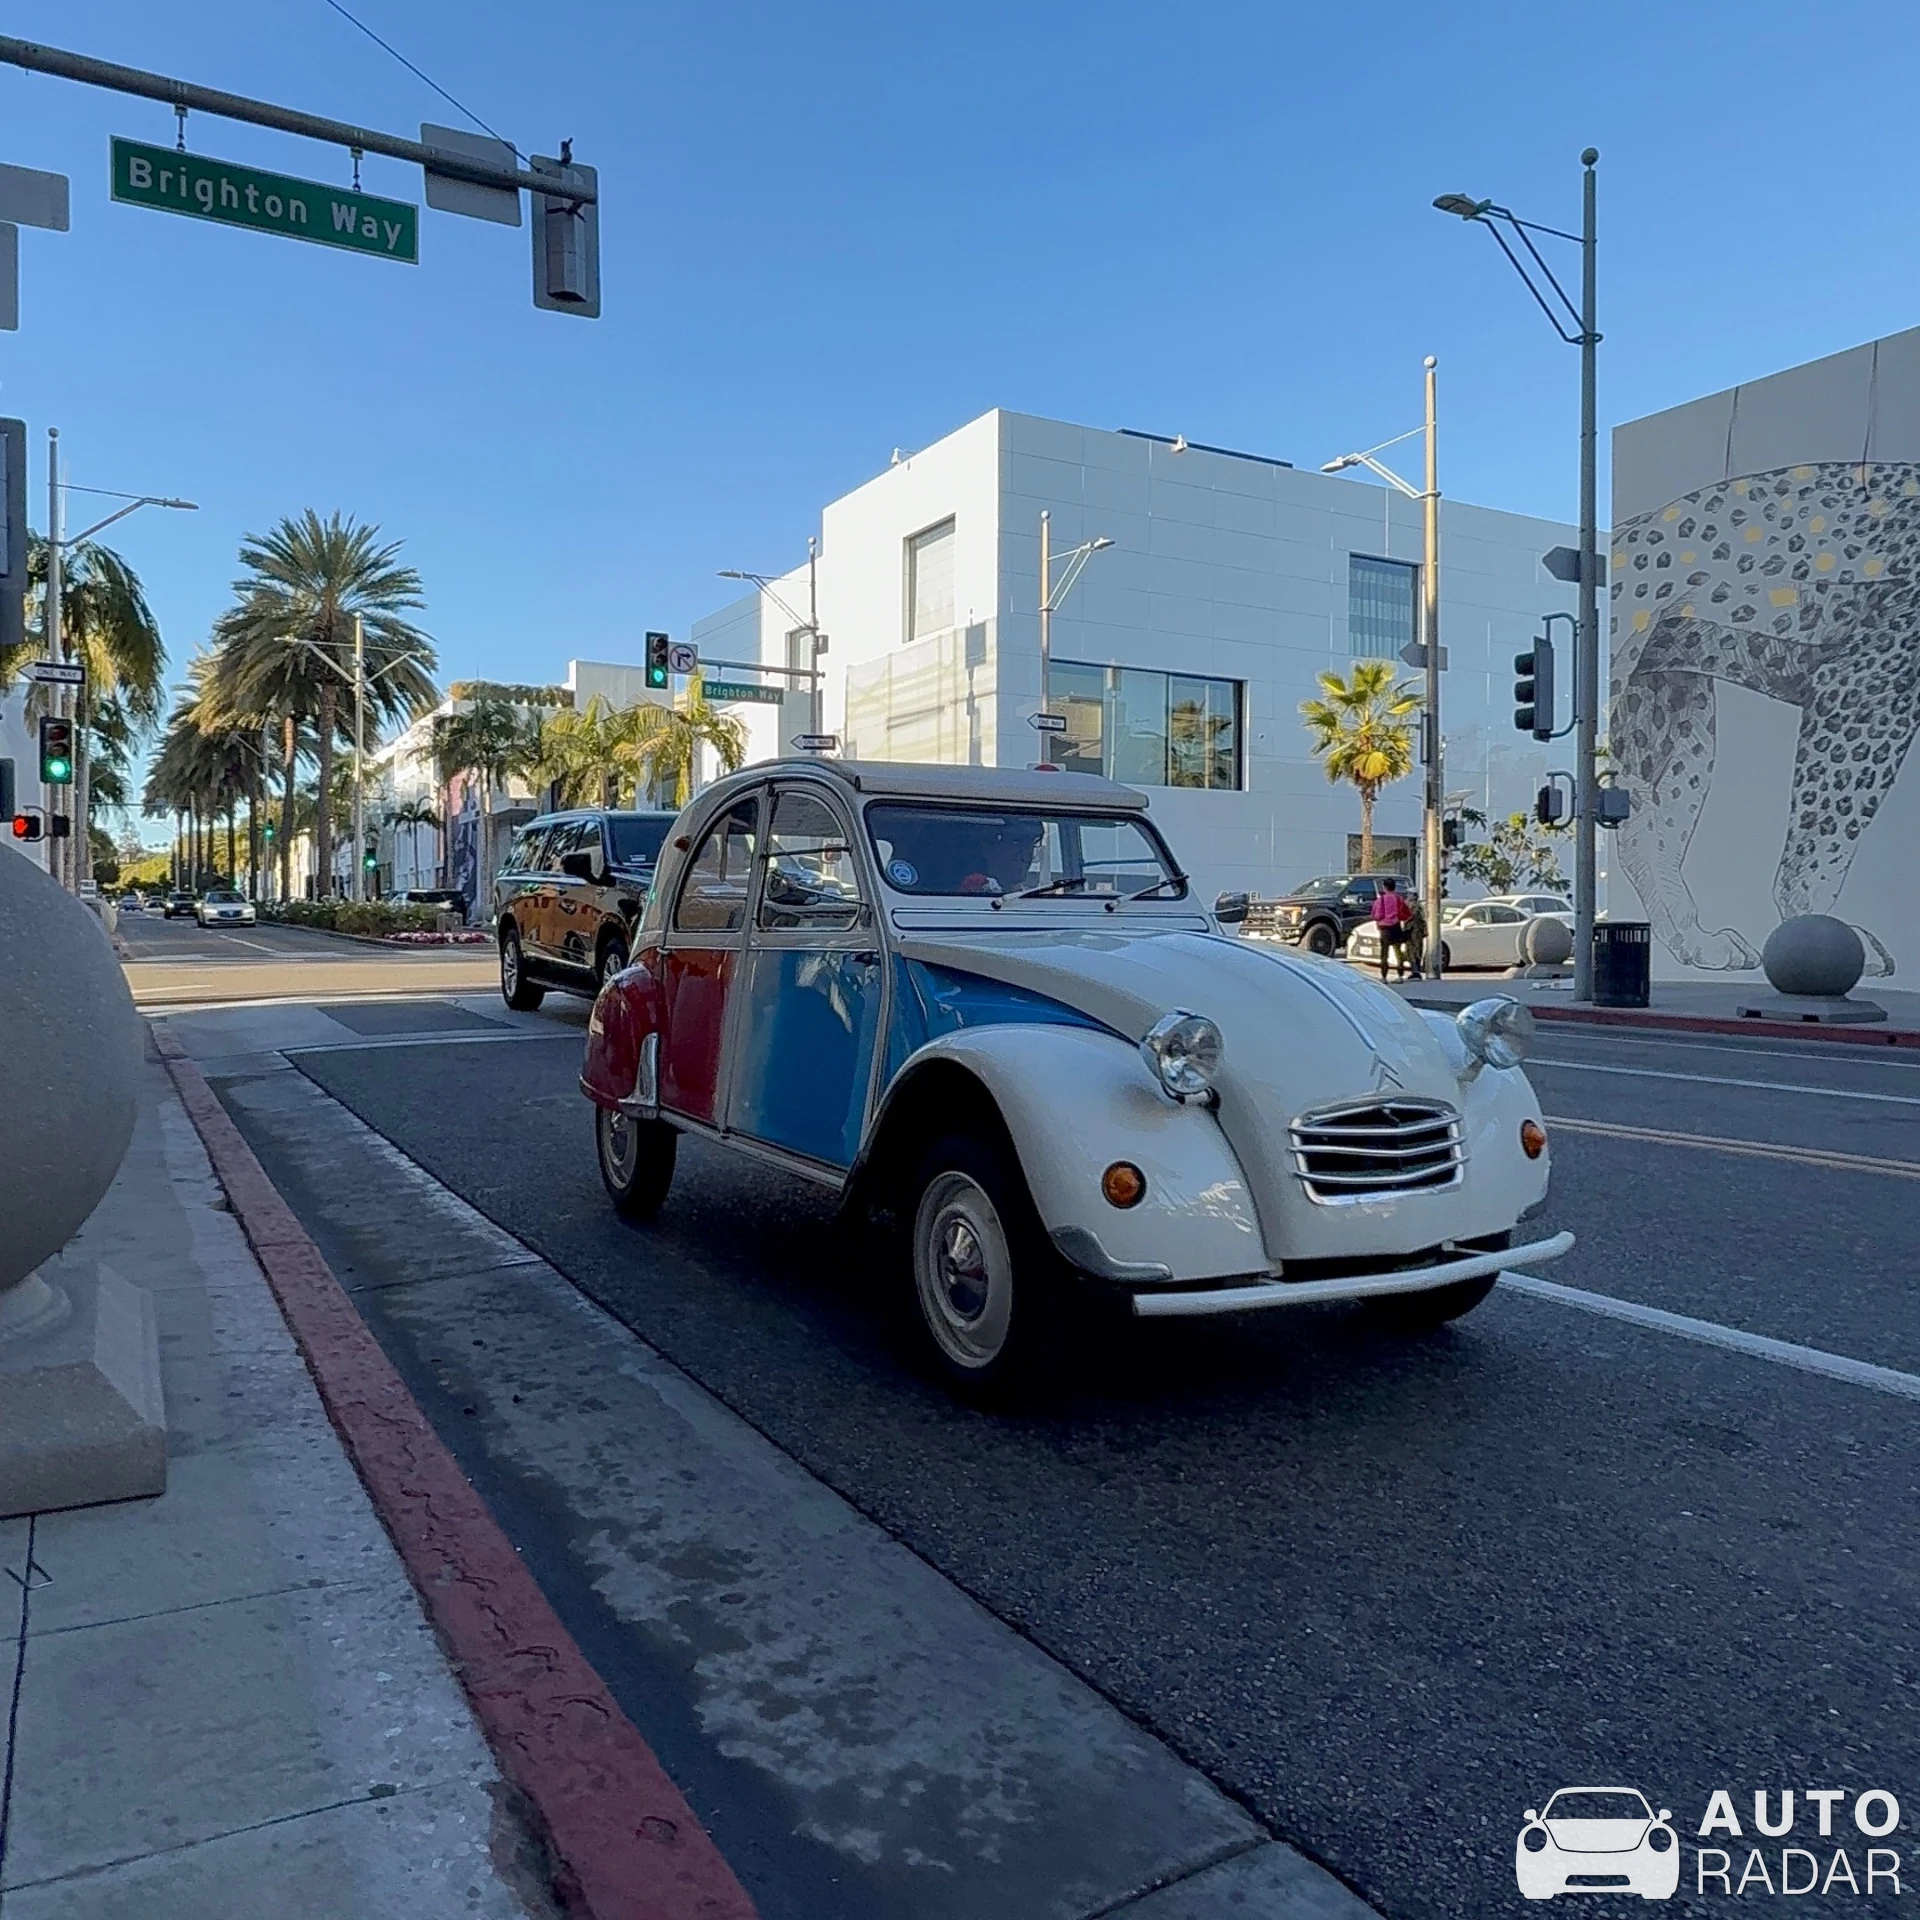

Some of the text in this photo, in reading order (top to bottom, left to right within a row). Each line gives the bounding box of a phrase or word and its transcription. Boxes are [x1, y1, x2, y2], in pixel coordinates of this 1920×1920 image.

[128, 156, 402, 250] Brighton Way
[36, 668, 78, 678] ONE WAY
[705, 685, 780, 702] Brighton Way
